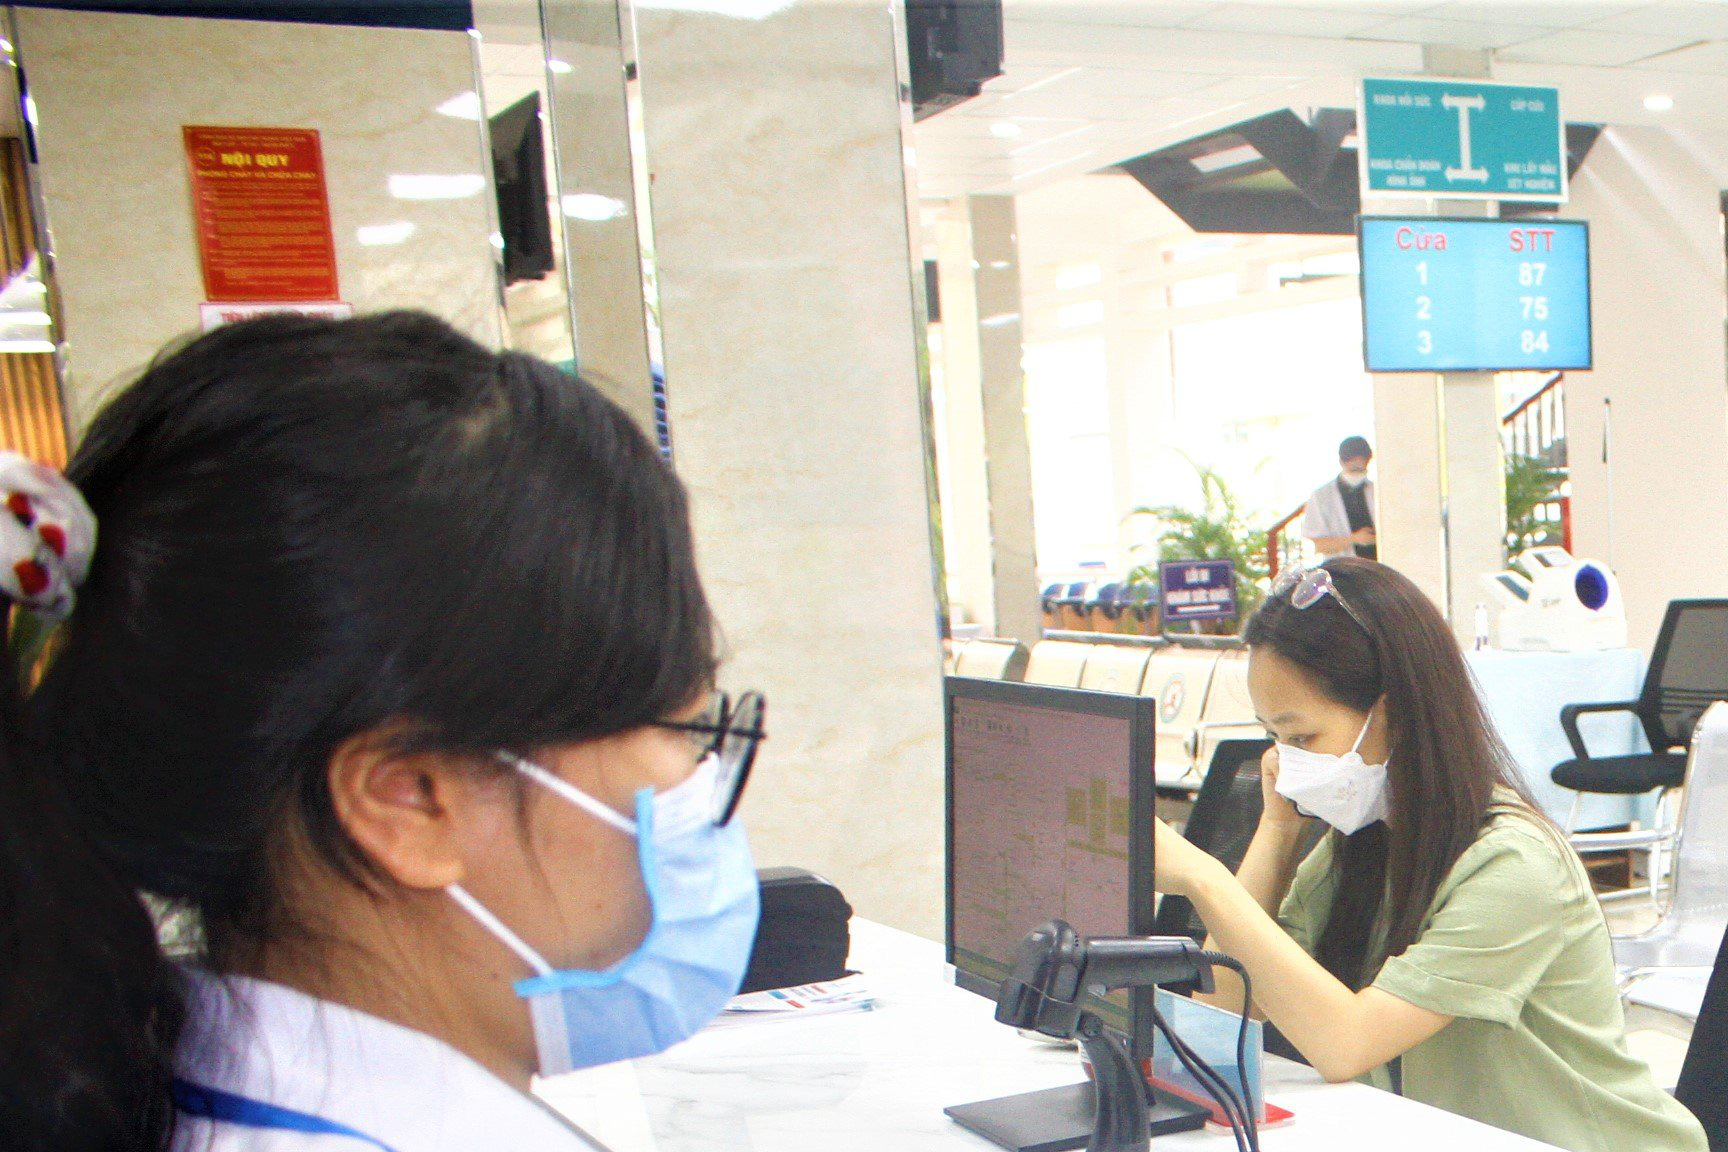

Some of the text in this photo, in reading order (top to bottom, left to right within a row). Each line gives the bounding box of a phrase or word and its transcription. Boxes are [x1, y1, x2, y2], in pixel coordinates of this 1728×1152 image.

[1395, 225, 1556, 252] Cửa STT
[1416, 262, 1547, 287] 1 87
[1416, 296, 1548, 320] 2 75
[1417, 330, 1549, 354] 3 84
